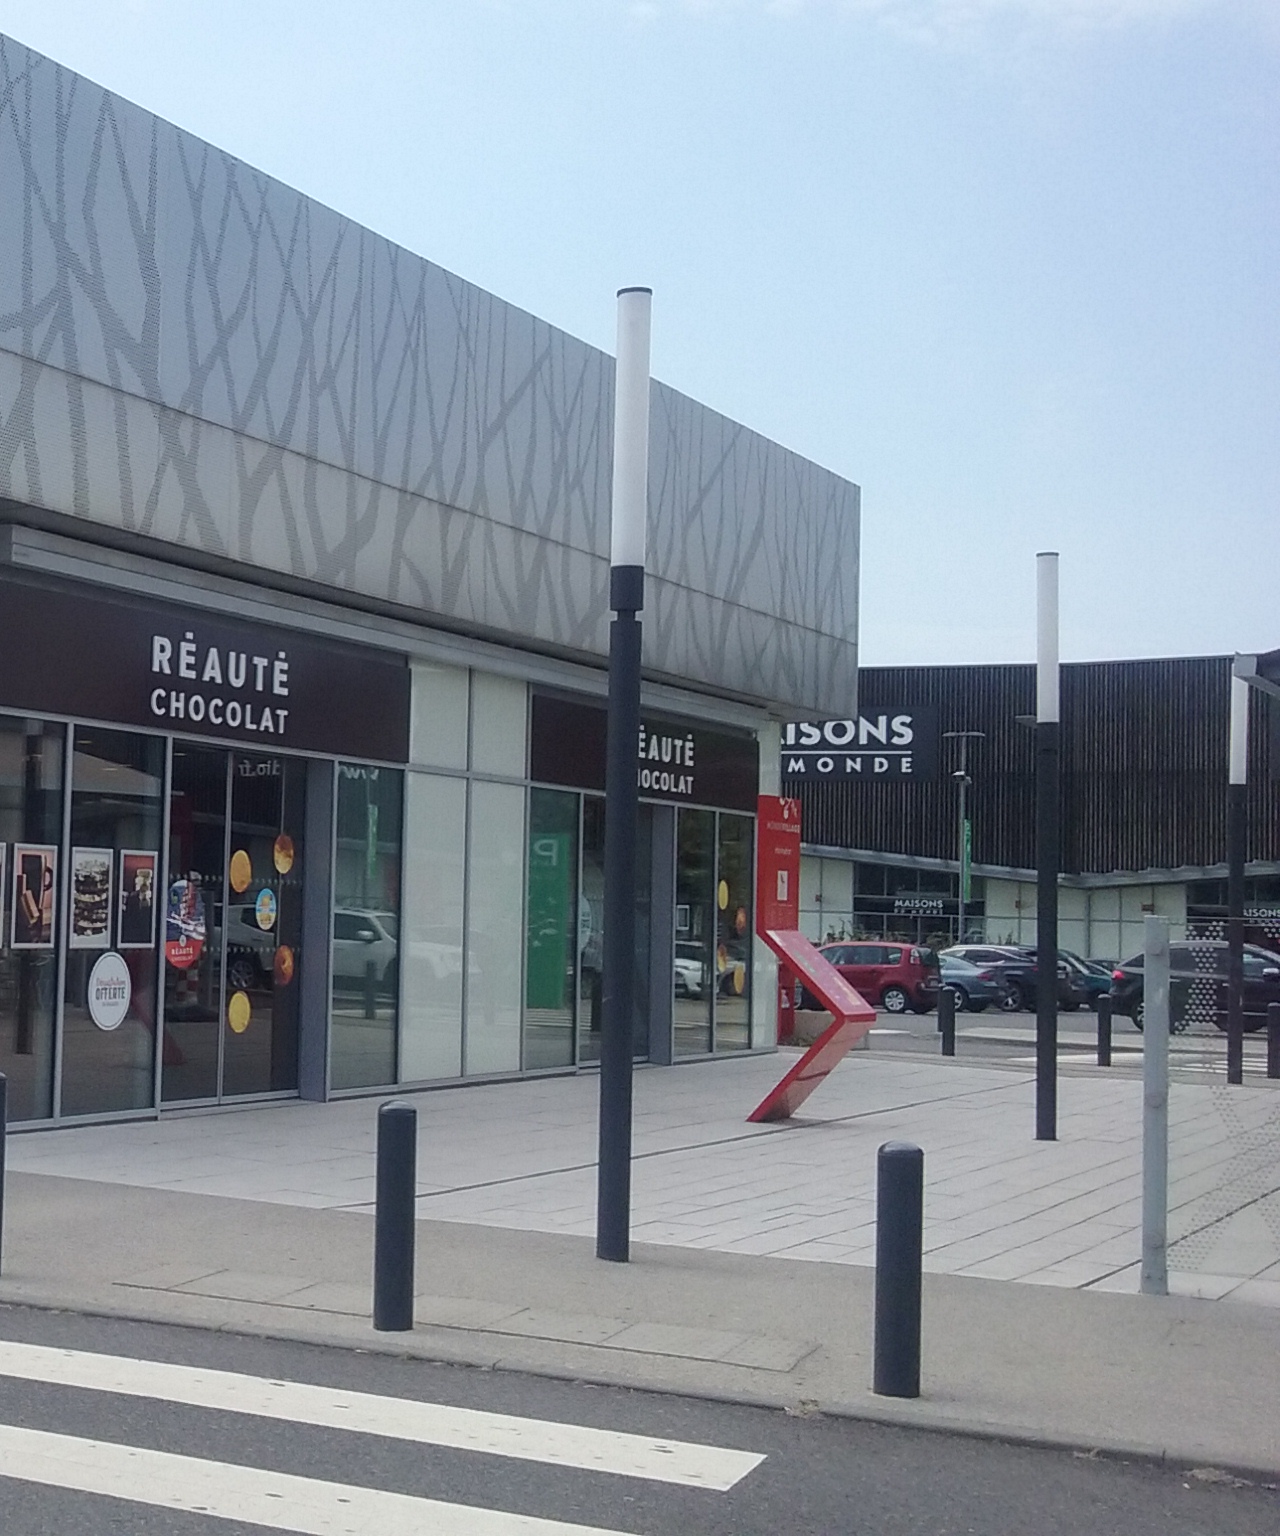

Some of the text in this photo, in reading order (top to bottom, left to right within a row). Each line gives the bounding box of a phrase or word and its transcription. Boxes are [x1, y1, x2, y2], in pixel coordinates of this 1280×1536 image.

[151, 631, 289, 696] RÉAUTÉ
[150, 688, 289, 734] CHOCOLAT
[780, 714, 914, 746] ISONS
[638, 724, 695, 767] ÉAUTÉ
[787, 756, 913, 773] MONDE
[637, 768, 694, 795] OCOLAT
[894, 899, 944, 908] MAISONS
[1243, 908, 1280, 918] AISONS
